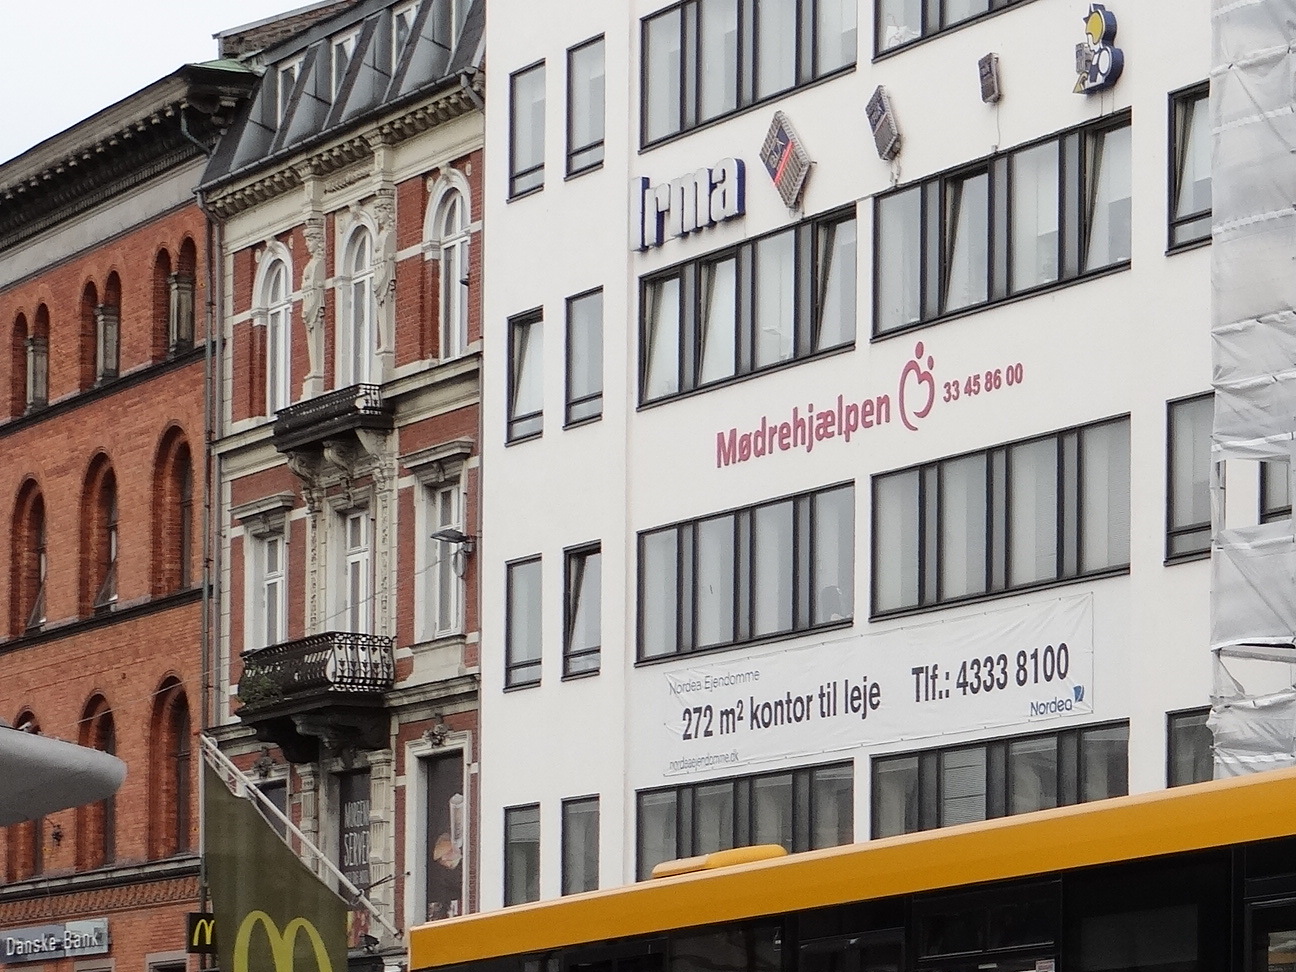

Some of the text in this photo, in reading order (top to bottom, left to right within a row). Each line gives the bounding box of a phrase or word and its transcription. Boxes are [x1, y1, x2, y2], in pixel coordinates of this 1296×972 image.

[631, 157, 746, 252] Irma
[717, 362, 1023, 467] Mødrehjælpen 33 45 86 00
[669, 670, 760, 696] Nordea Ejendomme
[912, 642, 1069, 703] Tlf.: 4333 8100
[682, 704, 713, 741] 272
[749, 691, 813, 731] kontor
[819, 682, 837, 719] til
[843, 675, 881, 719] leje
[1031, 696, 1073, 717] Nordea
[6, 930, 99, 956] Danske Bank
